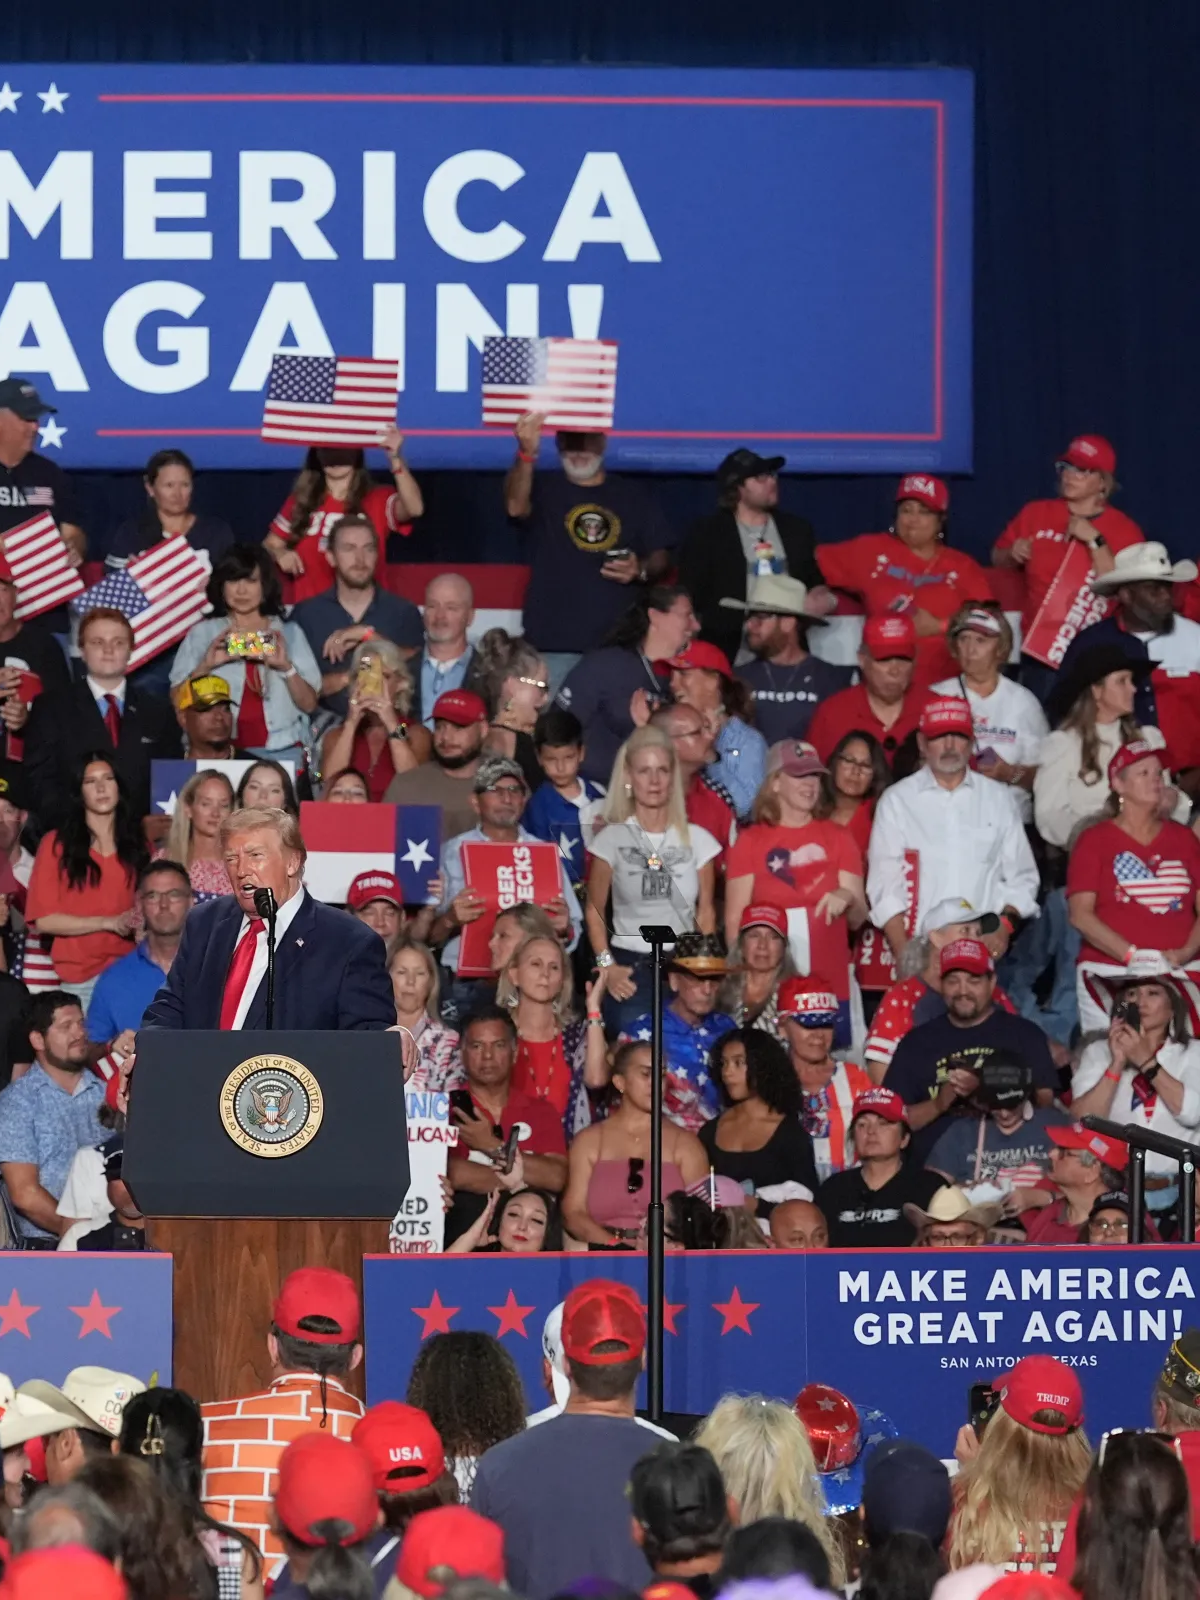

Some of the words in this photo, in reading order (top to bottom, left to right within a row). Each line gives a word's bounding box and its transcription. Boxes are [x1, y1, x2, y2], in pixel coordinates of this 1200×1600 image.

[904, 477, 936, 497] USA
[356, 876, 394, 891] TRUMP
[497, 865, 517, 910] GER
[513, 845, 535, 905] ECKS
[224, 1058, 271, 1102] PRESIDENT
[285, 1061, 298, 1072] THE
[300, 1071, 320, 1113] UNITED
[236, 1129, 262, 1152] SEAL
[280, 1122, 315, 1153] STATES
[839, 1270, 967, 1302] MAKE
[986, 1267, 1195, 1301] AMERICA
[854, 1312, 1003, 1345] GREAT
[1022, 1309, 1183, 1343] AGAIN!
[940, 1357, 969, 1369] SAN
[1054, 1355, 1098, 1367] TEXAS
[1036, 1392, 1070, 1406] TRUMP
[389, 1446, 423, 1462] USA
